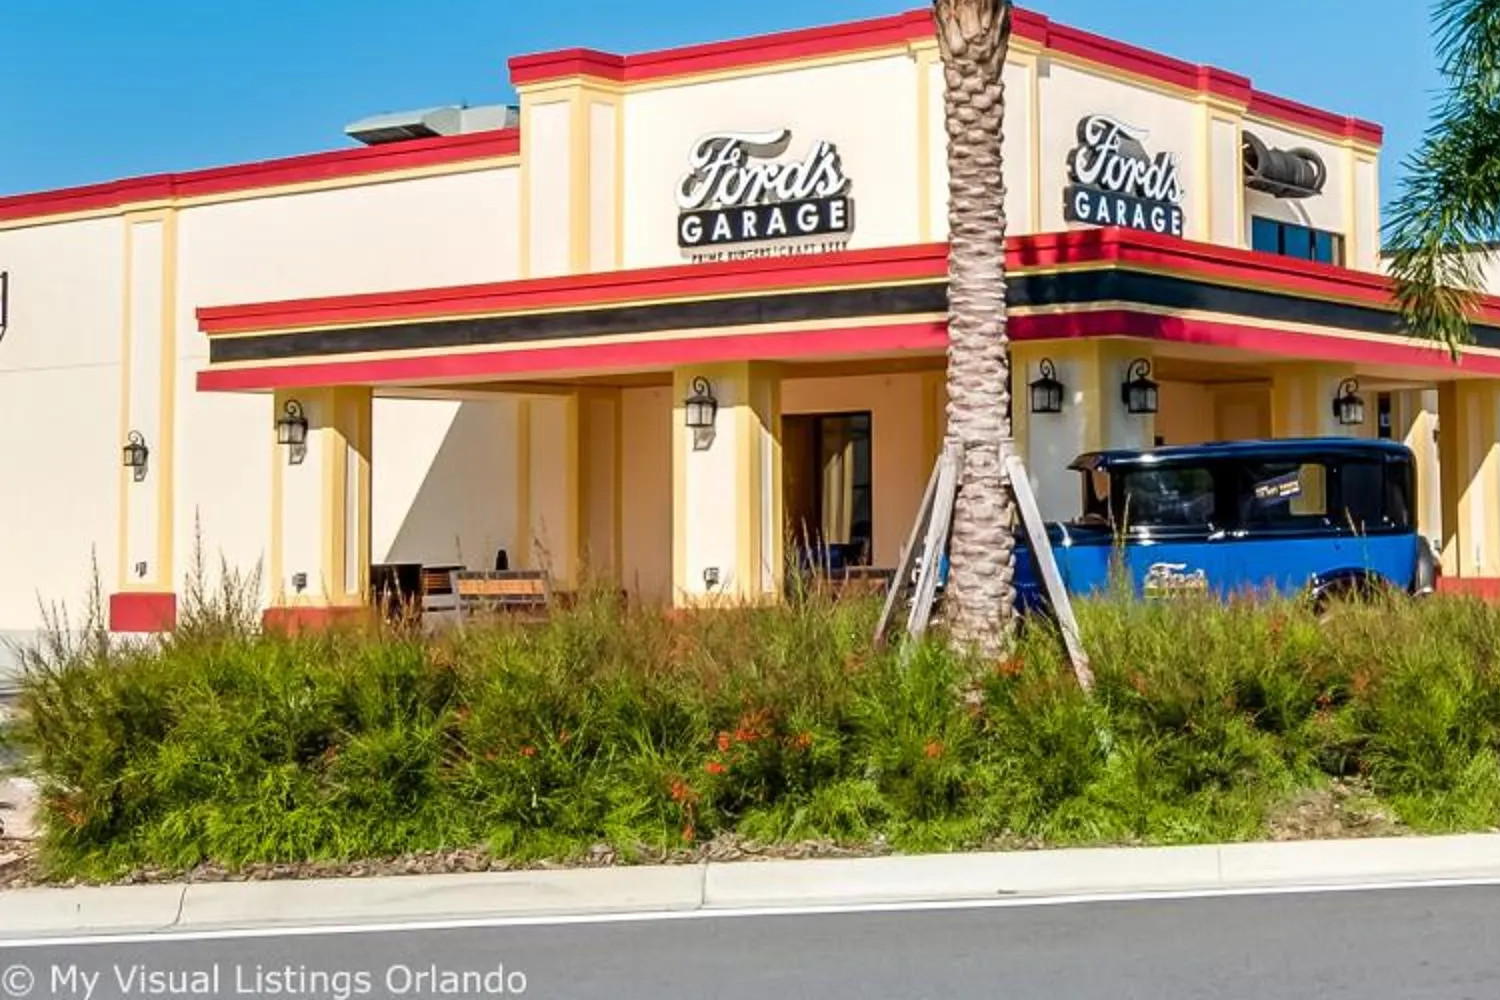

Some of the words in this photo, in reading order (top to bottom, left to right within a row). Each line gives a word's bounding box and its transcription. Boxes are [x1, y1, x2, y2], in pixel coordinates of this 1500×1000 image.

[674, 129, 848, 209] Ford's
[1074, 115, 1182, 202] Ford's
[681, 200, 845, 244] GARAGE
[1075, 191, 1181, 236] GARAGE
